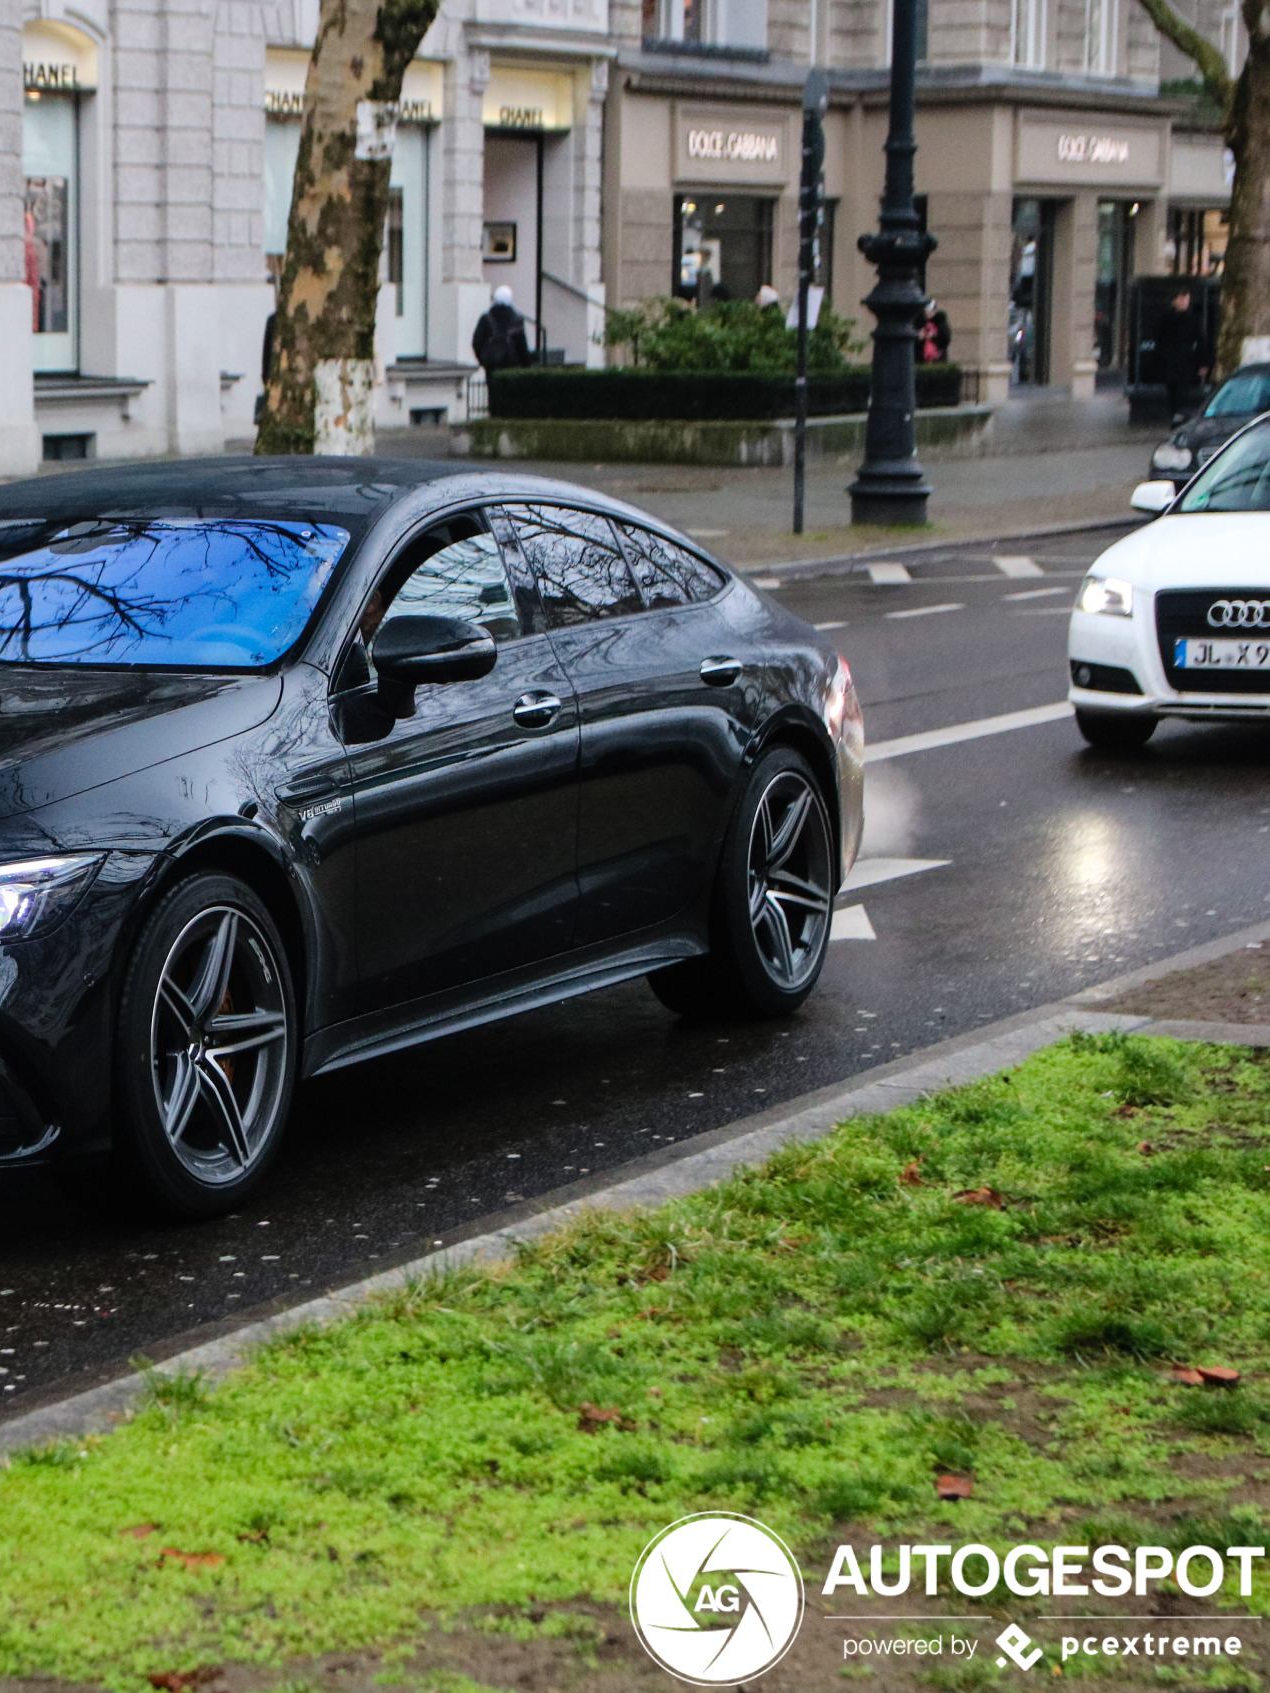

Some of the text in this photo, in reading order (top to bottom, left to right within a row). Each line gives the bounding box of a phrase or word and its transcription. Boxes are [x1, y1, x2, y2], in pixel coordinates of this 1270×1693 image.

[499, 105, 544, 127] CHANEL
[1194, 644, 1221, 665] JL
[1237, 643, 1250, 665] X
